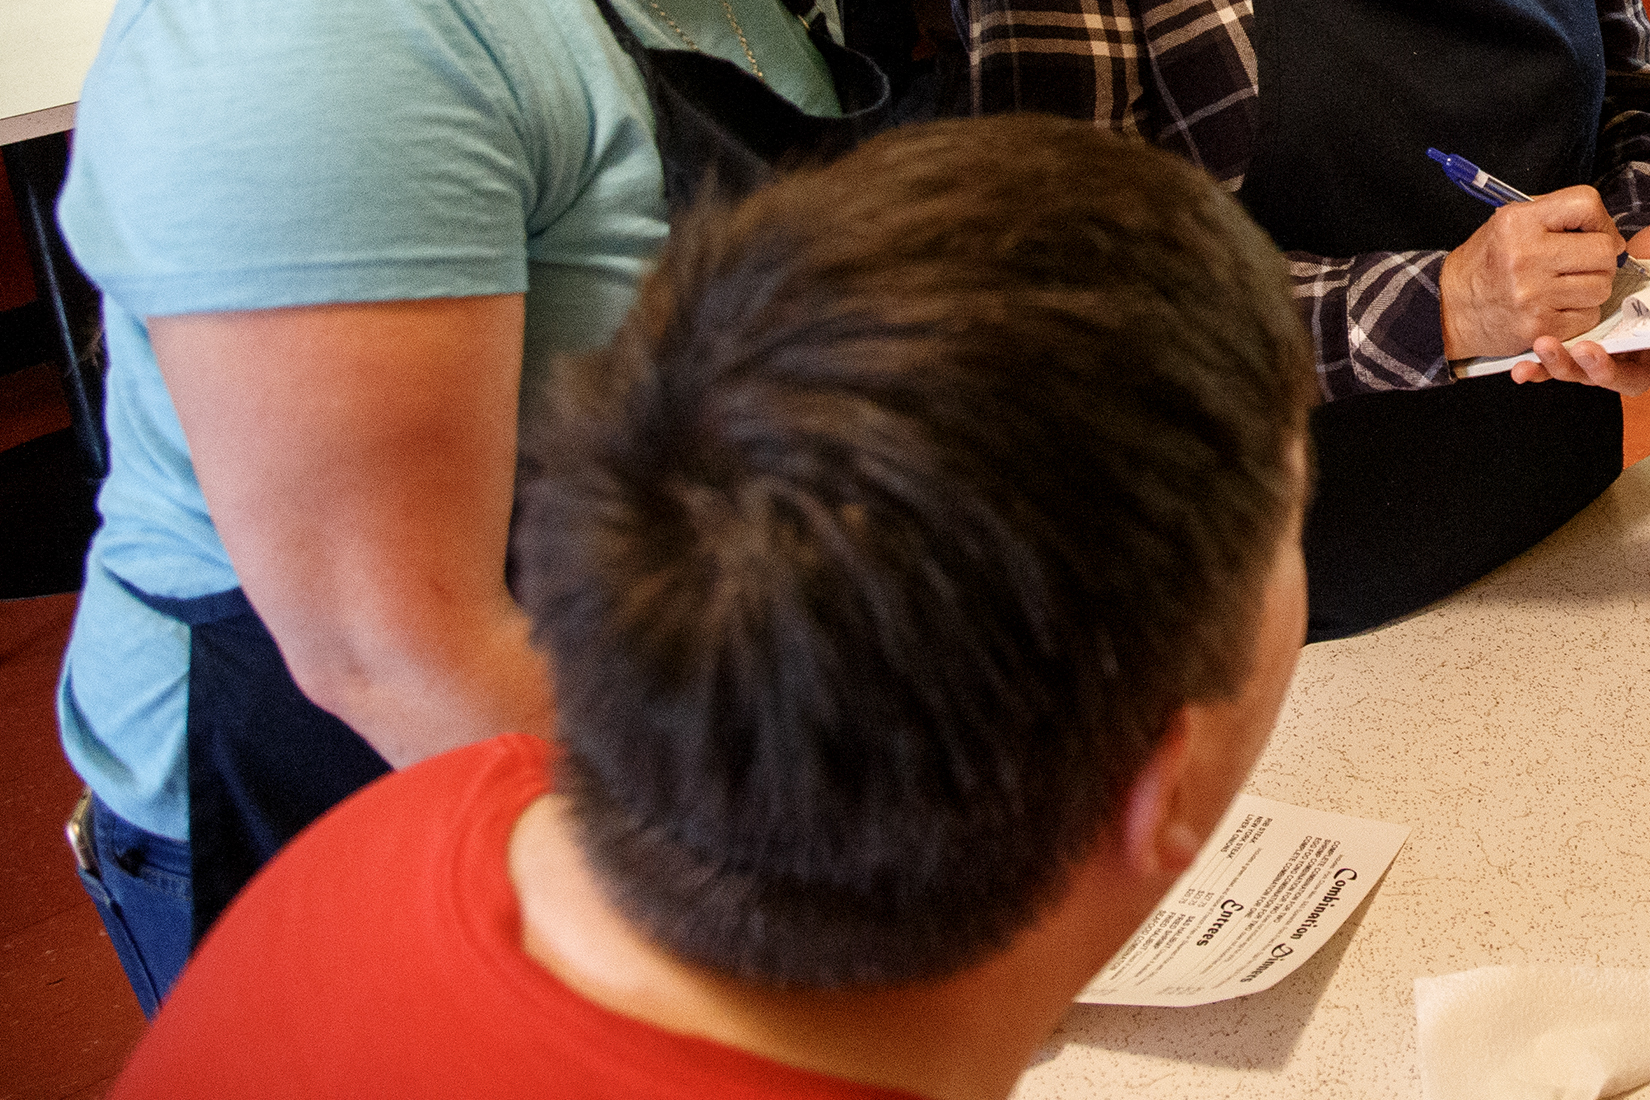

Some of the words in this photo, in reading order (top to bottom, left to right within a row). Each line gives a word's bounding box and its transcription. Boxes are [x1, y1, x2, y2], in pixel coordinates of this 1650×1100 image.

[1248, 827, 1265, 843] STEAK
[1251, 816, 1263, 827] NEW
[1261, 817, 1272, 827] RIB
[1290, 867, 1358, 940] Combination
[1196, 899, 1244, 946] Entrees
[1240, 943, 1293, 982] Dinners
